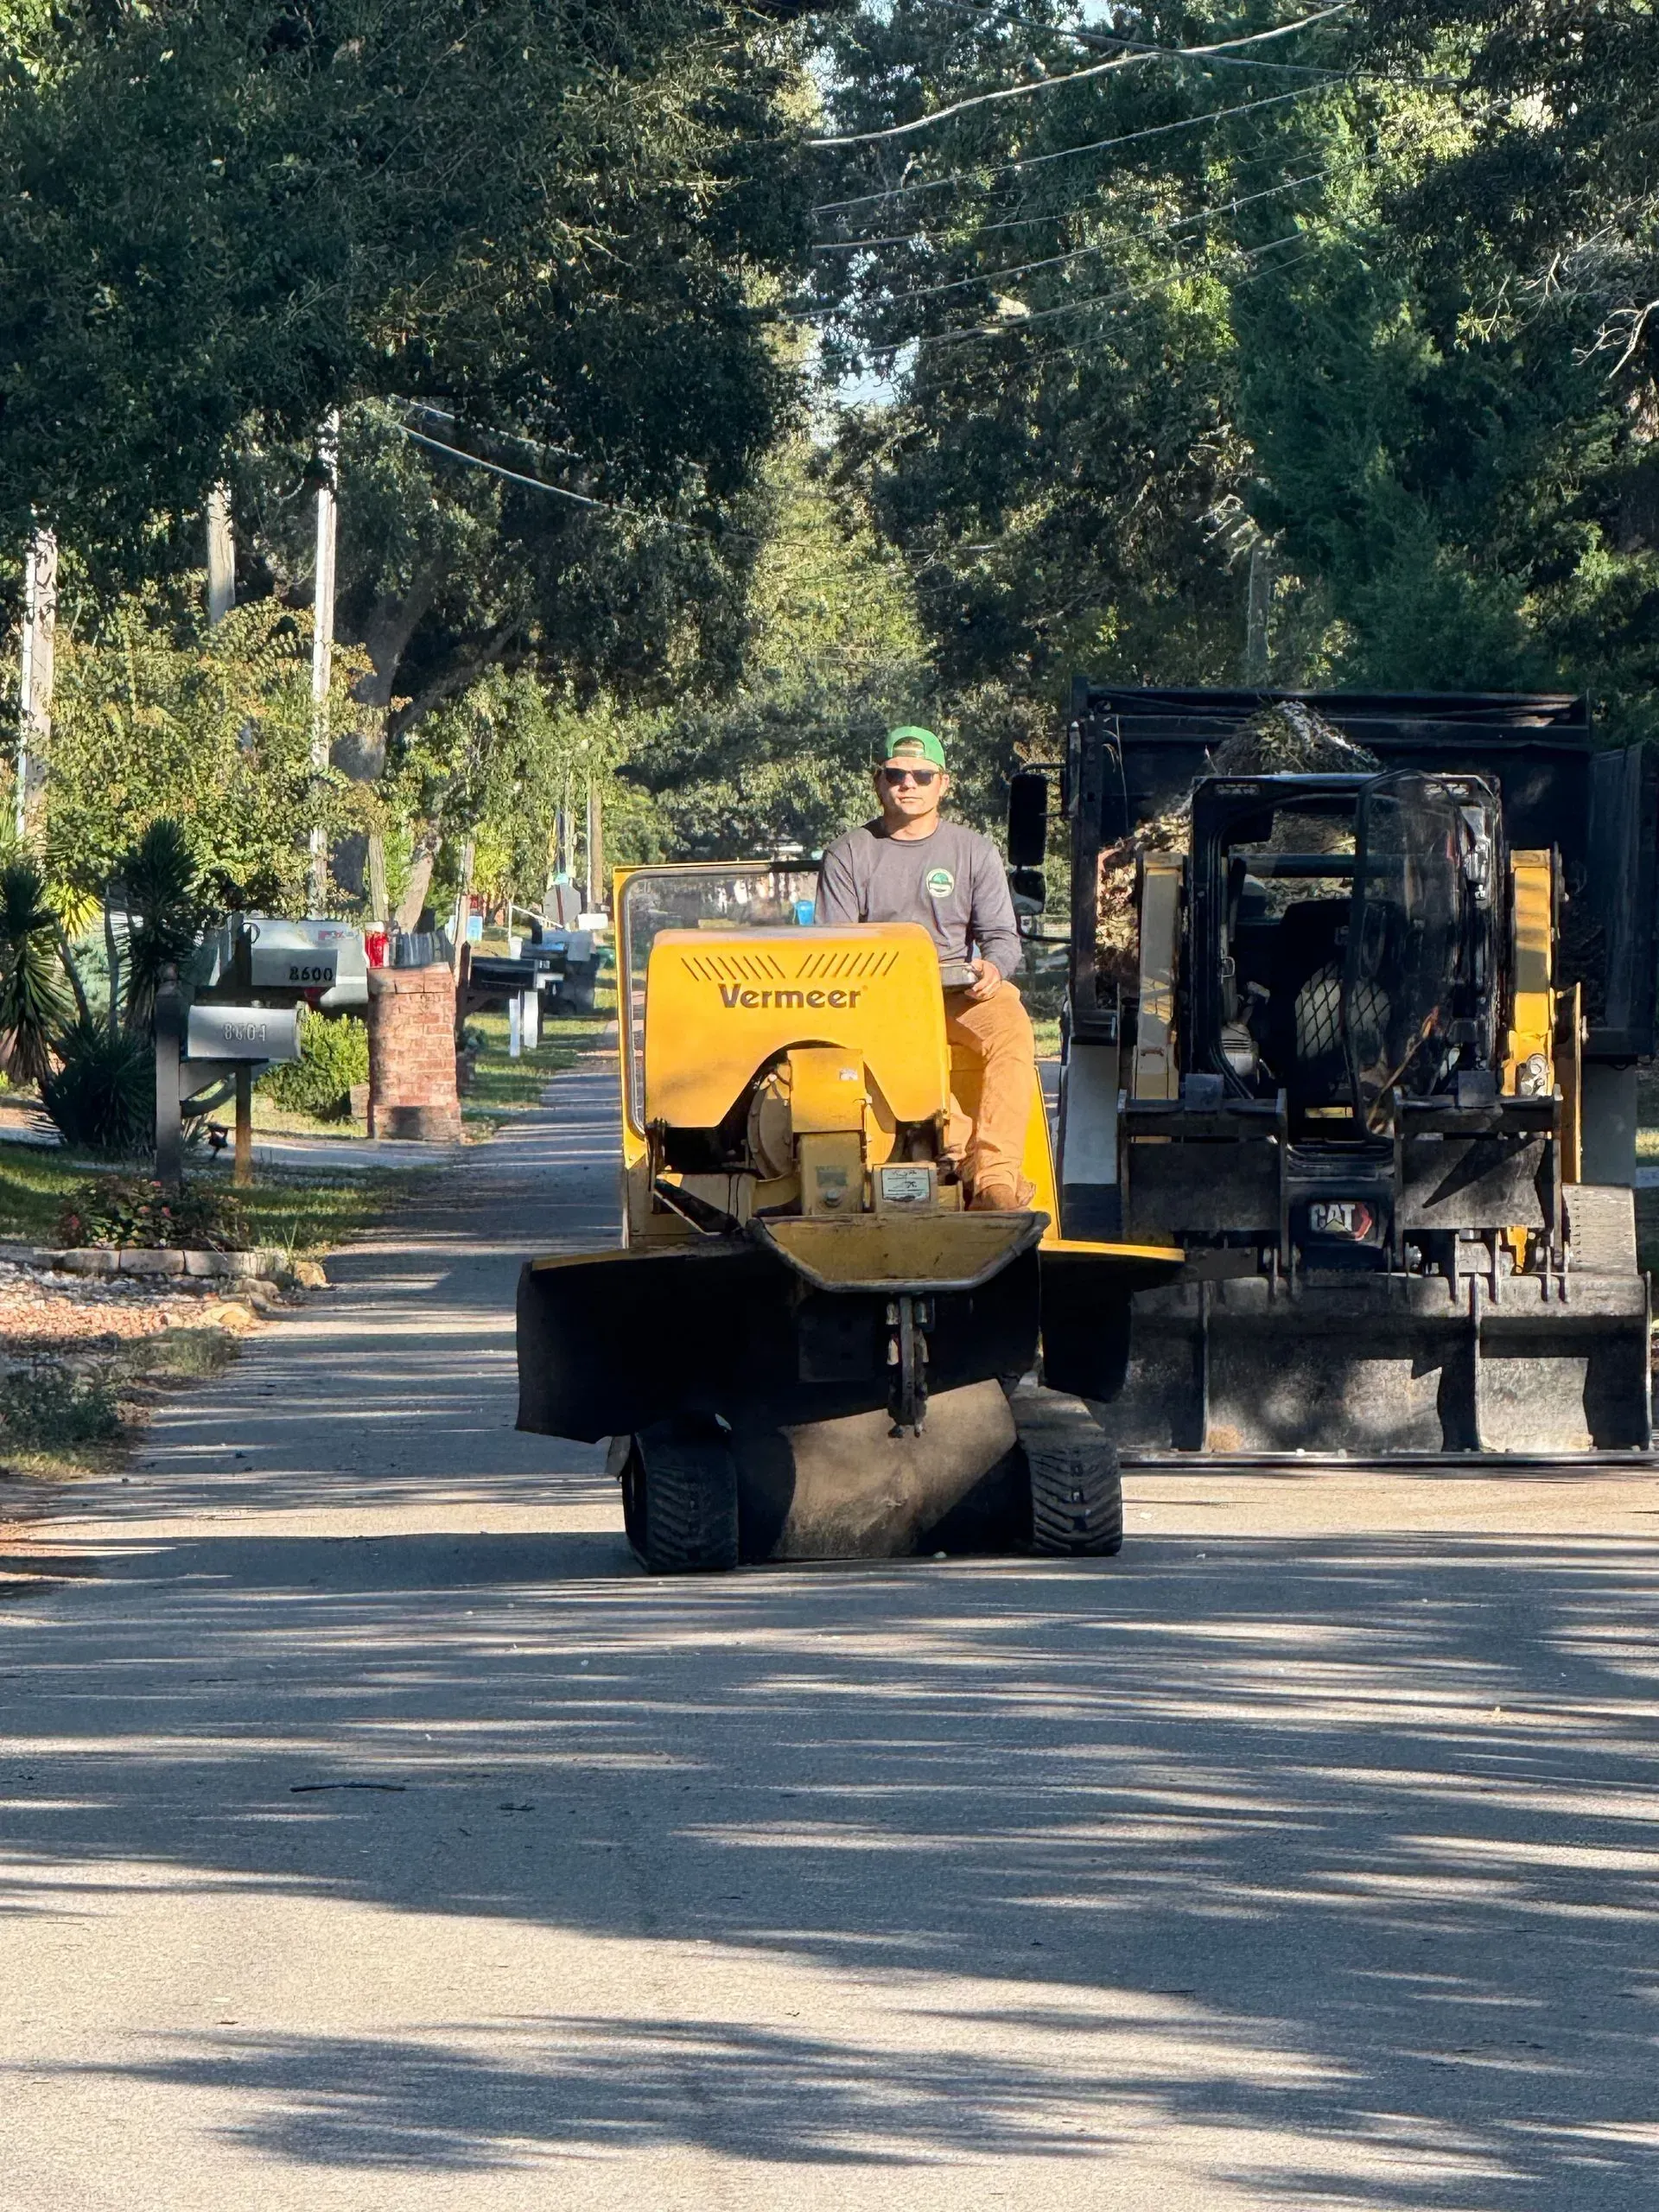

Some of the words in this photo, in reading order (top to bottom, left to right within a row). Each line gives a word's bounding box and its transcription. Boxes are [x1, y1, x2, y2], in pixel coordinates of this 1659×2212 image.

[289, 966, 334, 982] 8600
[717, 982, 861, 1009] Vermeer
[1310, 1203, 1356, 1232] CAT
